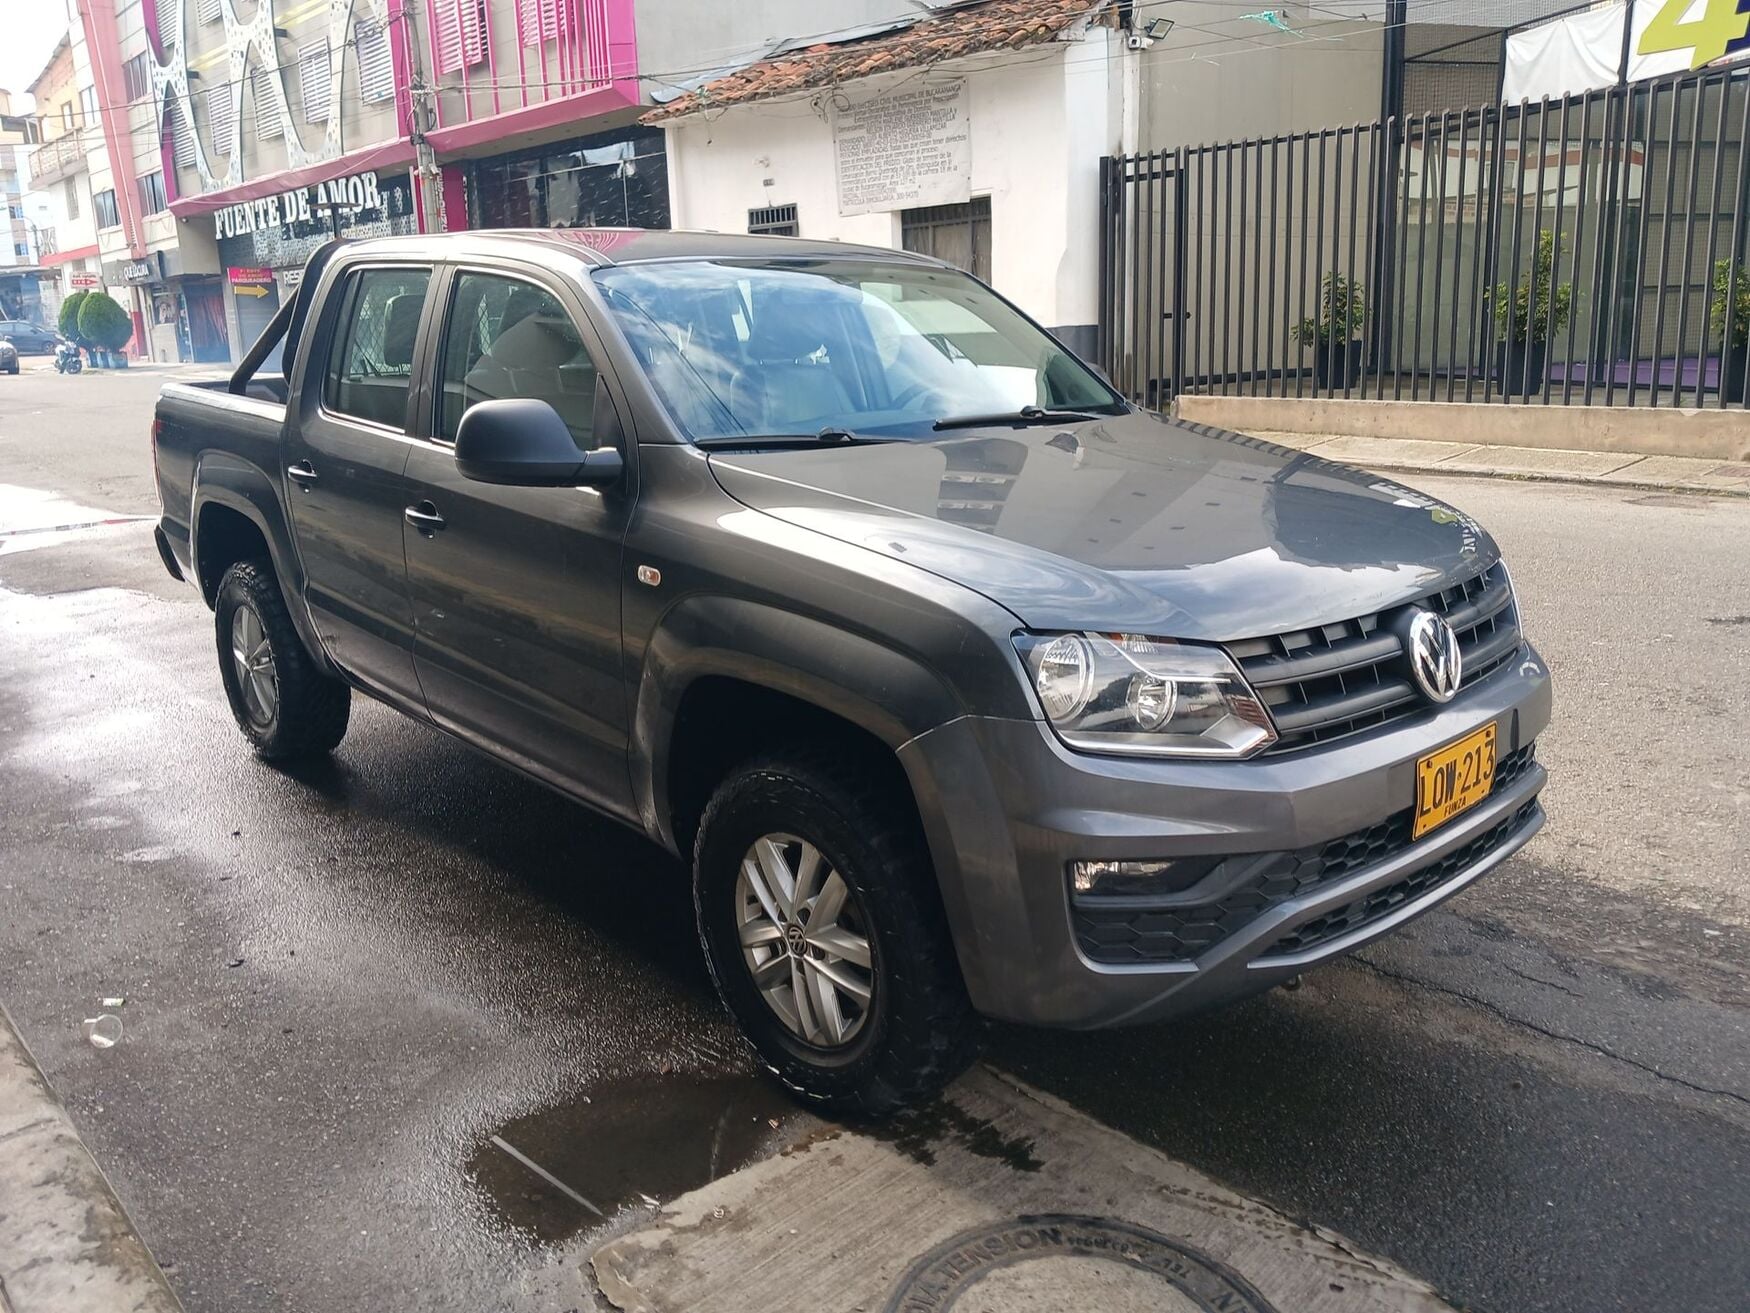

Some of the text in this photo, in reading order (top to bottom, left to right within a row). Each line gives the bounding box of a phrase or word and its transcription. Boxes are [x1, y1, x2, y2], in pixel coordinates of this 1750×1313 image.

[214, 171, 381, 240] FUENTE DE AMOR
[1444, 796, 1467, 818] FUNZA
[935, 1227, 1063, 1281] TENSION
